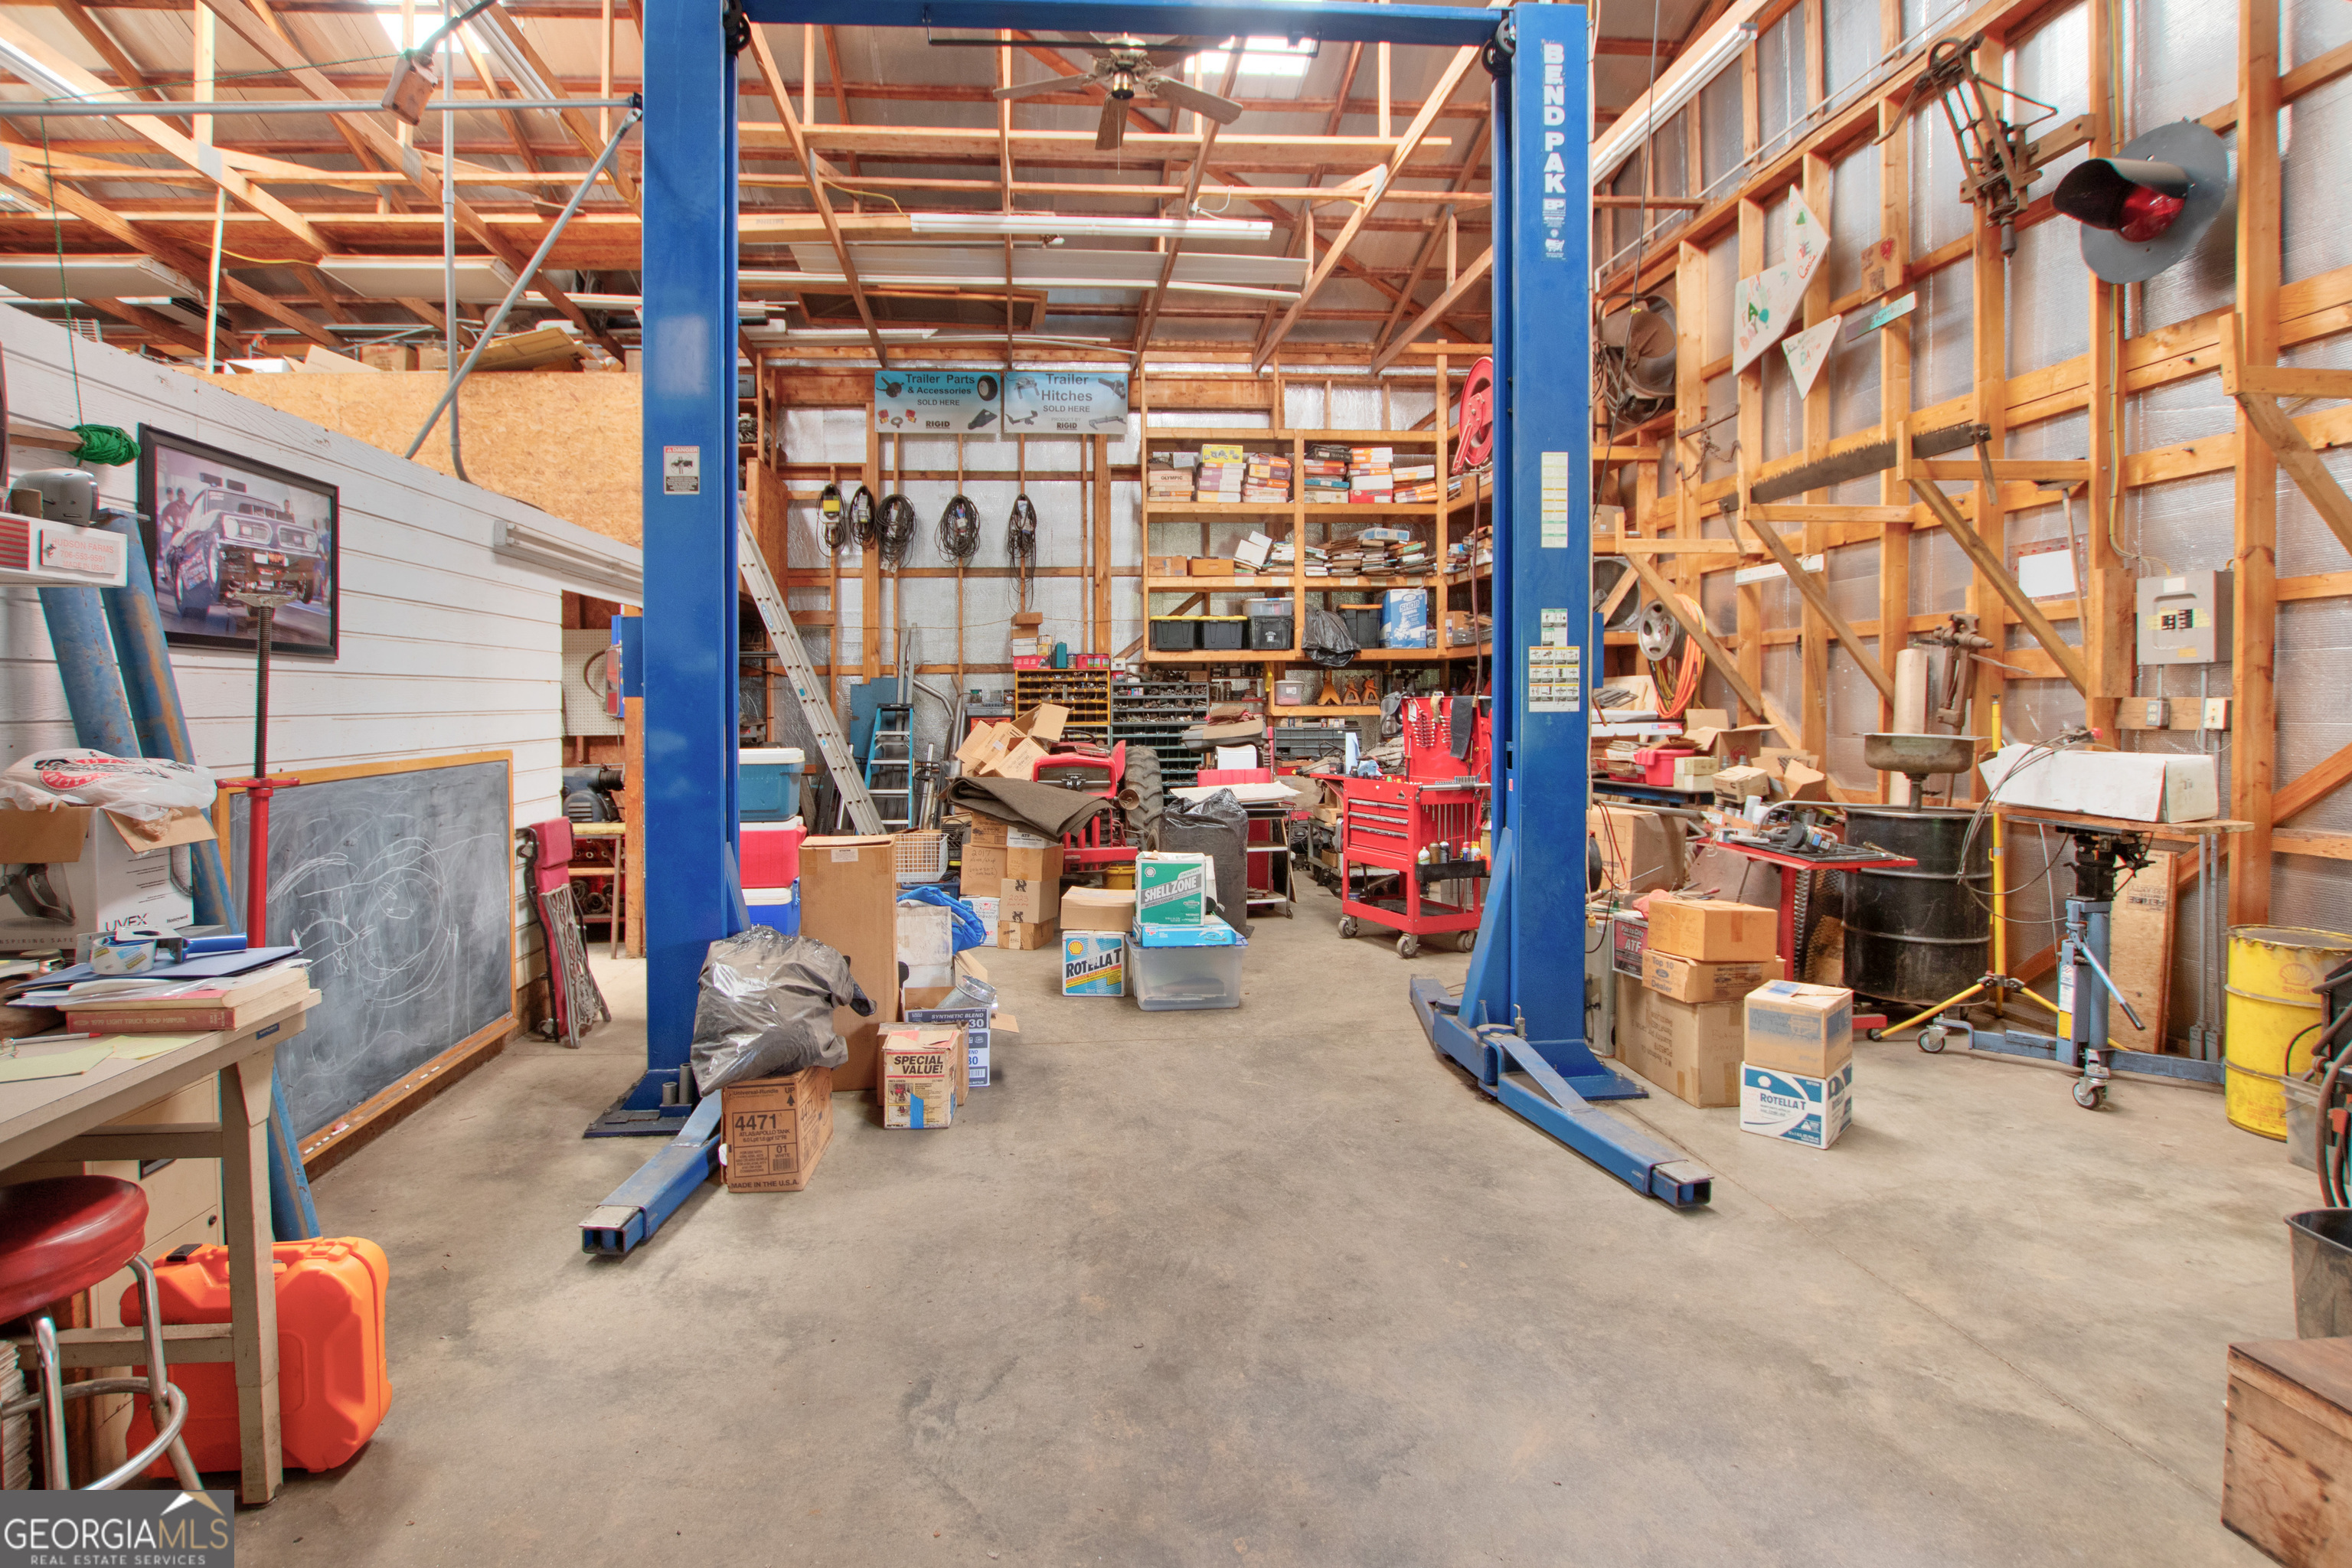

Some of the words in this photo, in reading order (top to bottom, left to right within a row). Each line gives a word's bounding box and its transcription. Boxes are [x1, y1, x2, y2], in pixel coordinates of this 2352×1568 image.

[905, 374, 940, 384] Trailer
[947, 374, 975, 384] Parts
[1045, 374, 1089, 385] Trailer
[1041, 390, 1093, 401] Hitches
[51, 537, 87, 550] HUDSON
[88, 542, 114, 554] FARMS
[63, 560, 82, 569] MADE
[166, 914, 188, 923] Honeywell
[1625, 938, 1642, 952] ATF
[1114, 947, 1122, 963] T
[1652, 956, 1664, 967] Top
[1666, 961, 1674, 969] 10
[1651, 979, 1672, 993] Dealer
[2282, 986, 2310, 995] Shell
[893, 1055, 943, 1065] SPECIAL
[903, 1065, 943, 1074] VALUE!
[1760, 1093, 1799, 1109] ROTELLA
[1800, 1101, 1806, 1110] T
[735, 1113, 776, 1131] 4471
[776, 1145, 787, 1153] 01
